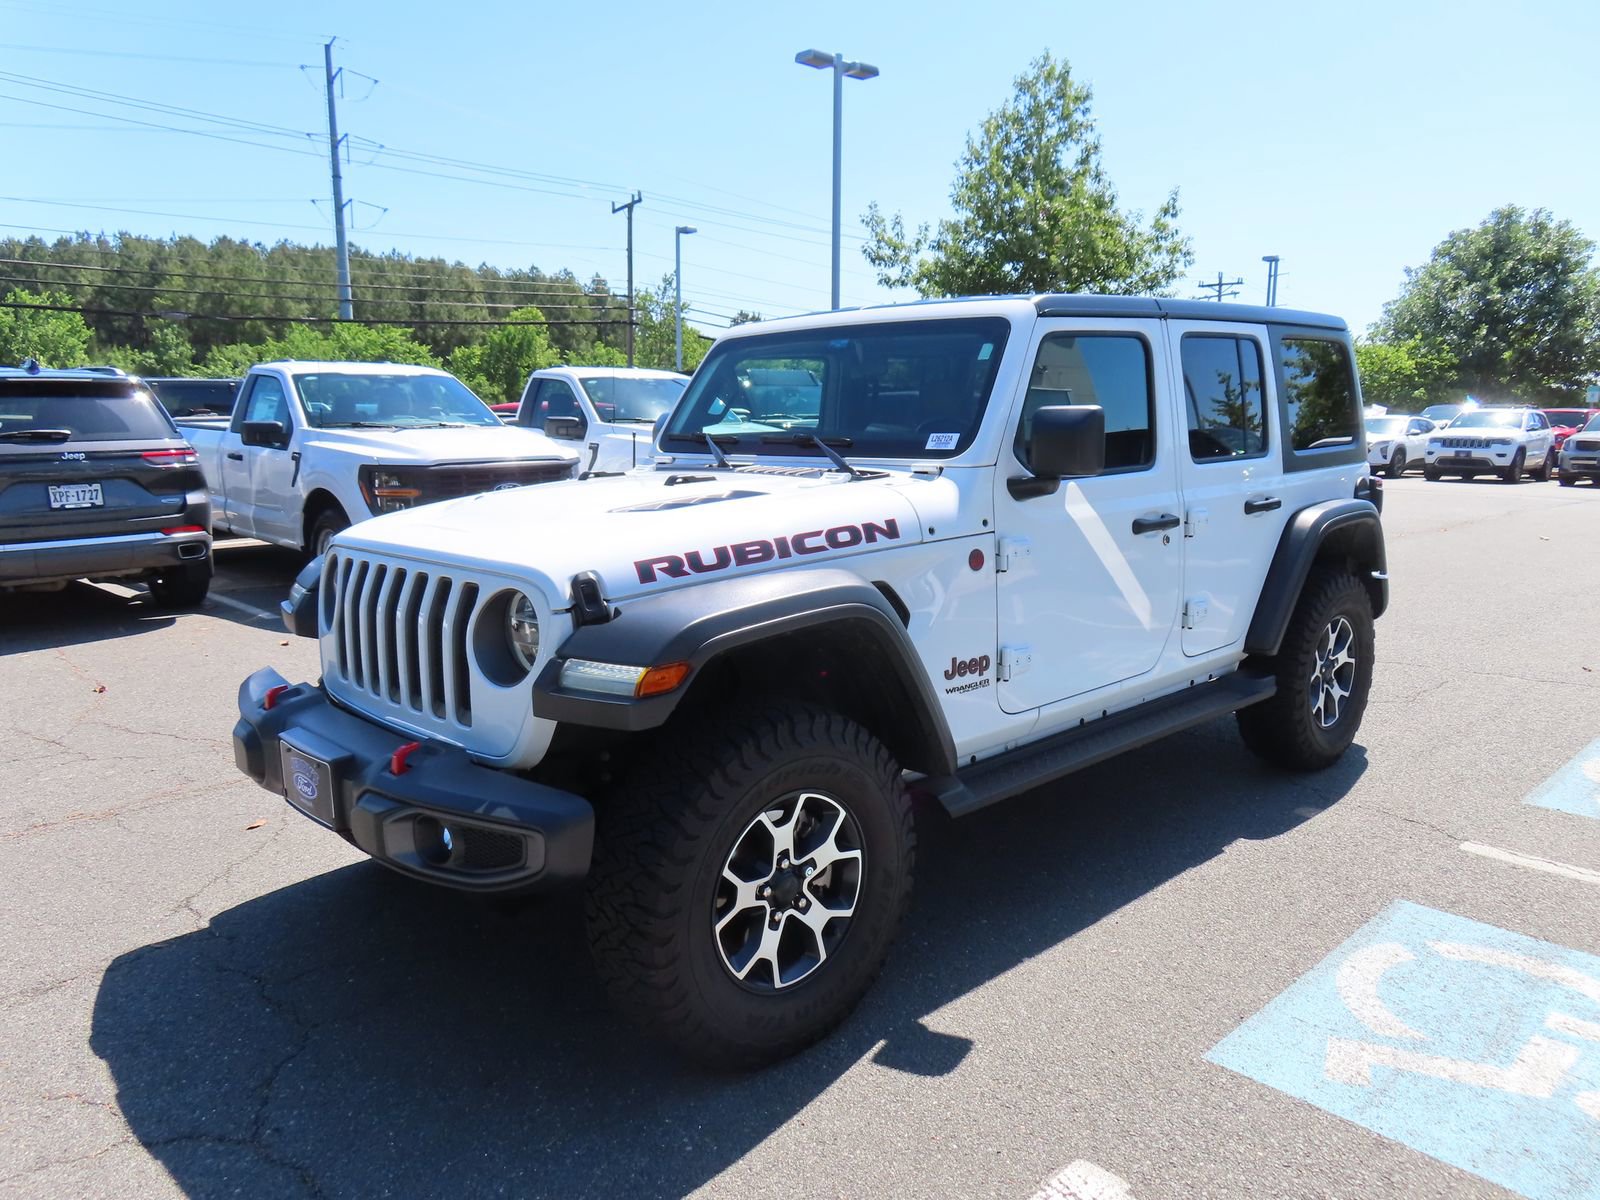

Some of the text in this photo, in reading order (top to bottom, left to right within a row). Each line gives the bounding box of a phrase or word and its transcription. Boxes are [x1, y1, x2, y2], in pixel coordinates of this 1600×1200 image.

[61, 452, 86, 461] Jeep
[52, 489, 99, 503] XPF-1727
[633, 518, 901, 585] RUBICON
[944, 655, 990, 680] Jeep
[945, 678, 990, 694] WRANGLER
[297, 776, 313, 796] Ford
